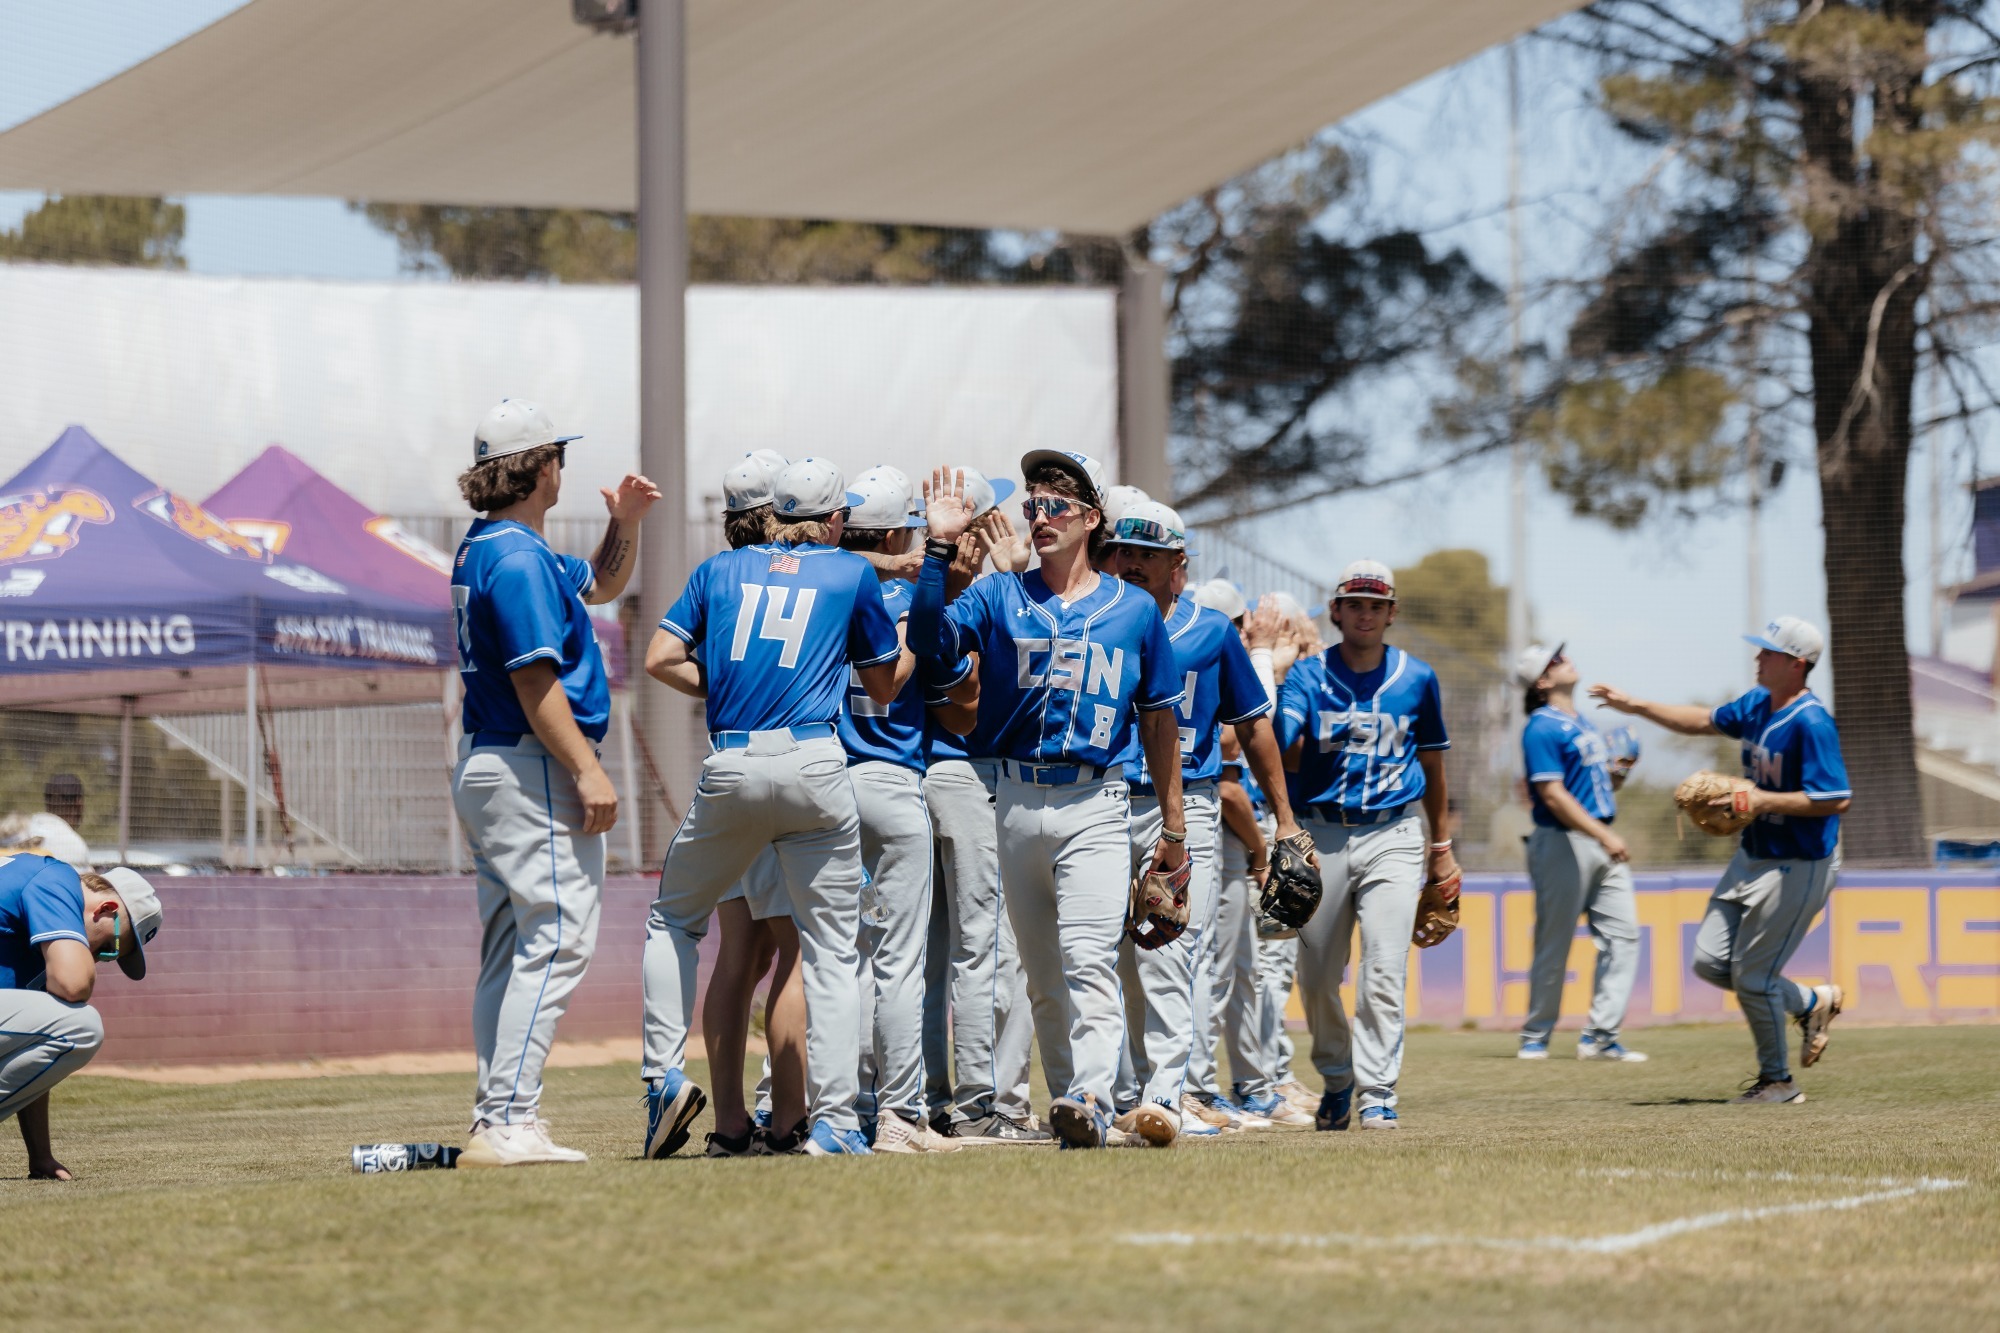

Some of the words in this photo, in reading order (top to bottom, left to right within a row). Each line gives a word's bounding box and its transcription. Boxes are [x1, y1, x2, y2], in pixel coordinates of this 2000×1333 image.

[0, 615, 195, 661] RAINING
[730, 582, 818, 669] 14
[1012, 637, 1124, 700] CSN
[1089, 703, 1117, 750] 8
[1317, 710, 1410, 757] CSN
